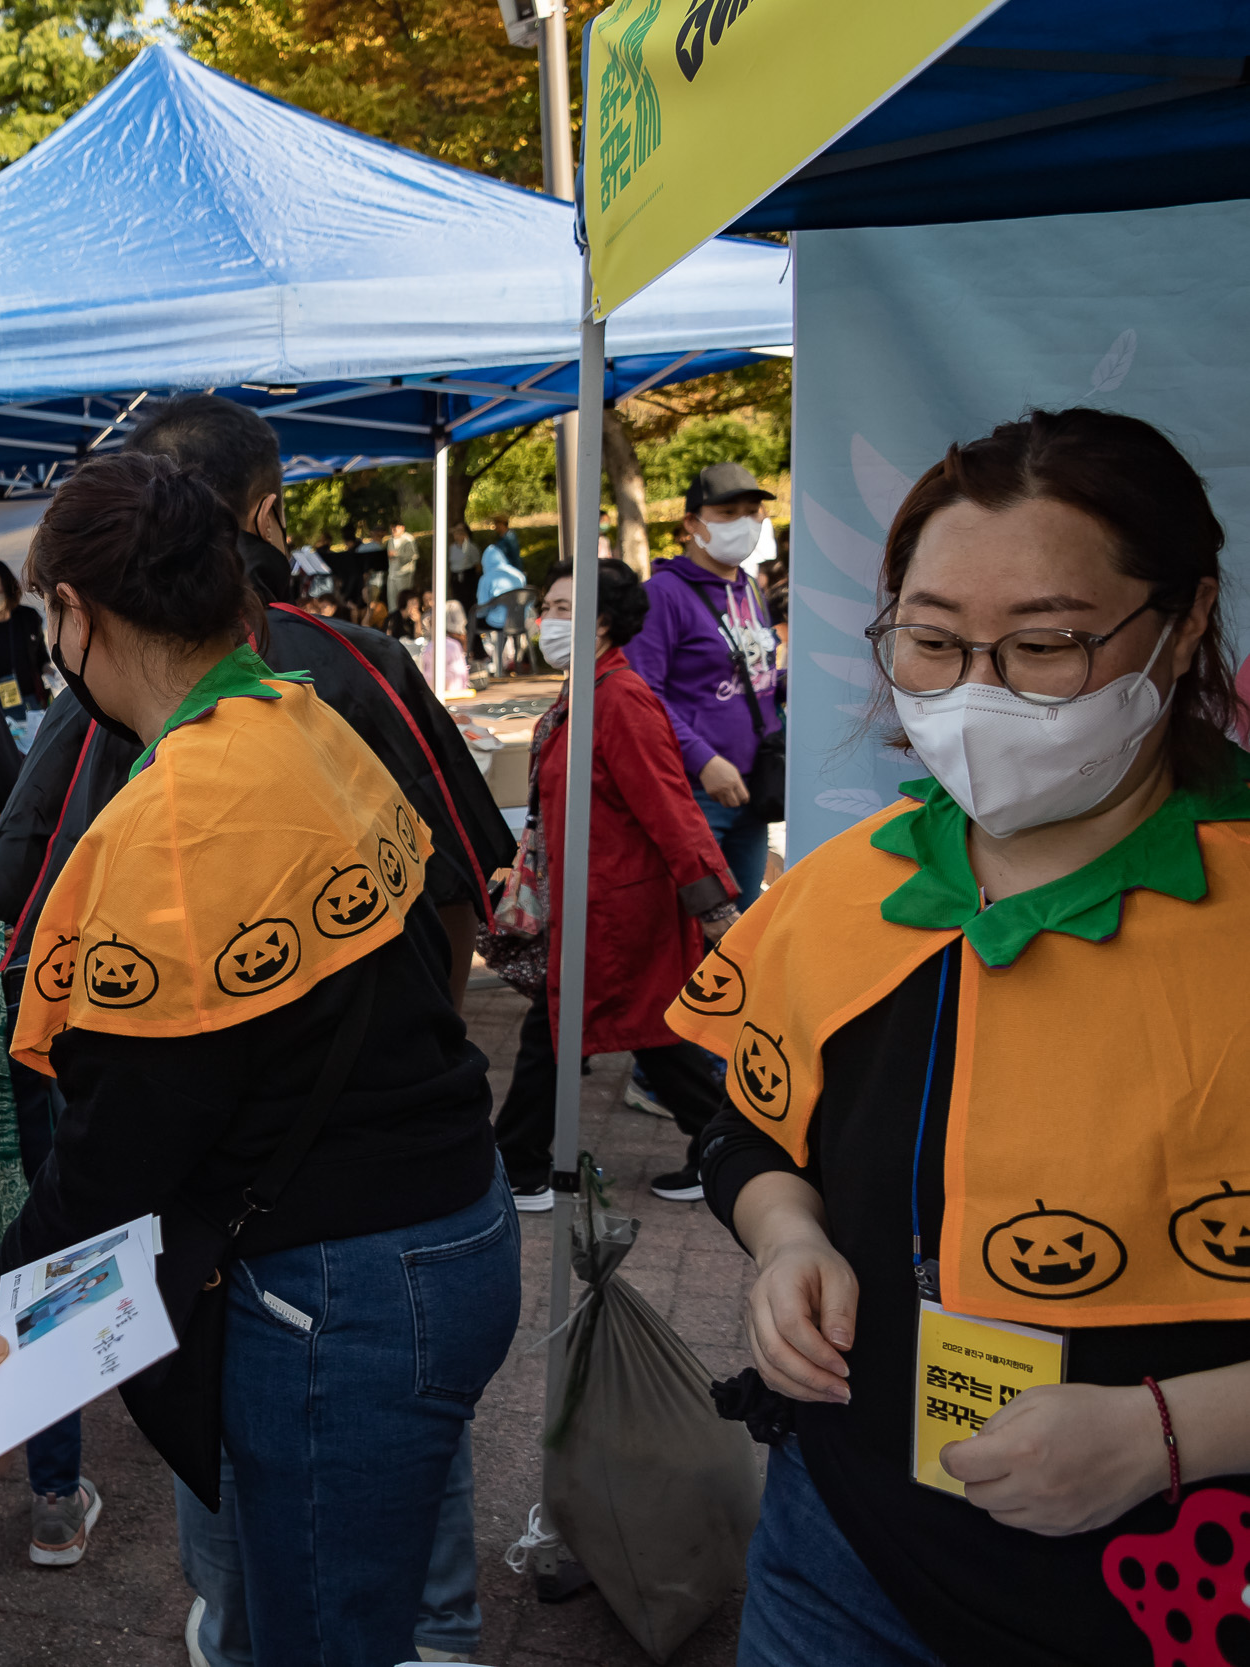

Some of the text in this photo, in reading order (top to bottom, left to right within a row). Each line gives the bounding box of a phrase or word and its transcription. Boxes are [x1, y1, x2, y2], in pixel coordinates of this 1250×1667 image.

[942, 1341, 1034, 1373] 2022 광진구 마을자치한마당
[927, 1364, 992, 1403] 춤추는
[927, 1396, 989, 1431] 꿈꾸는
